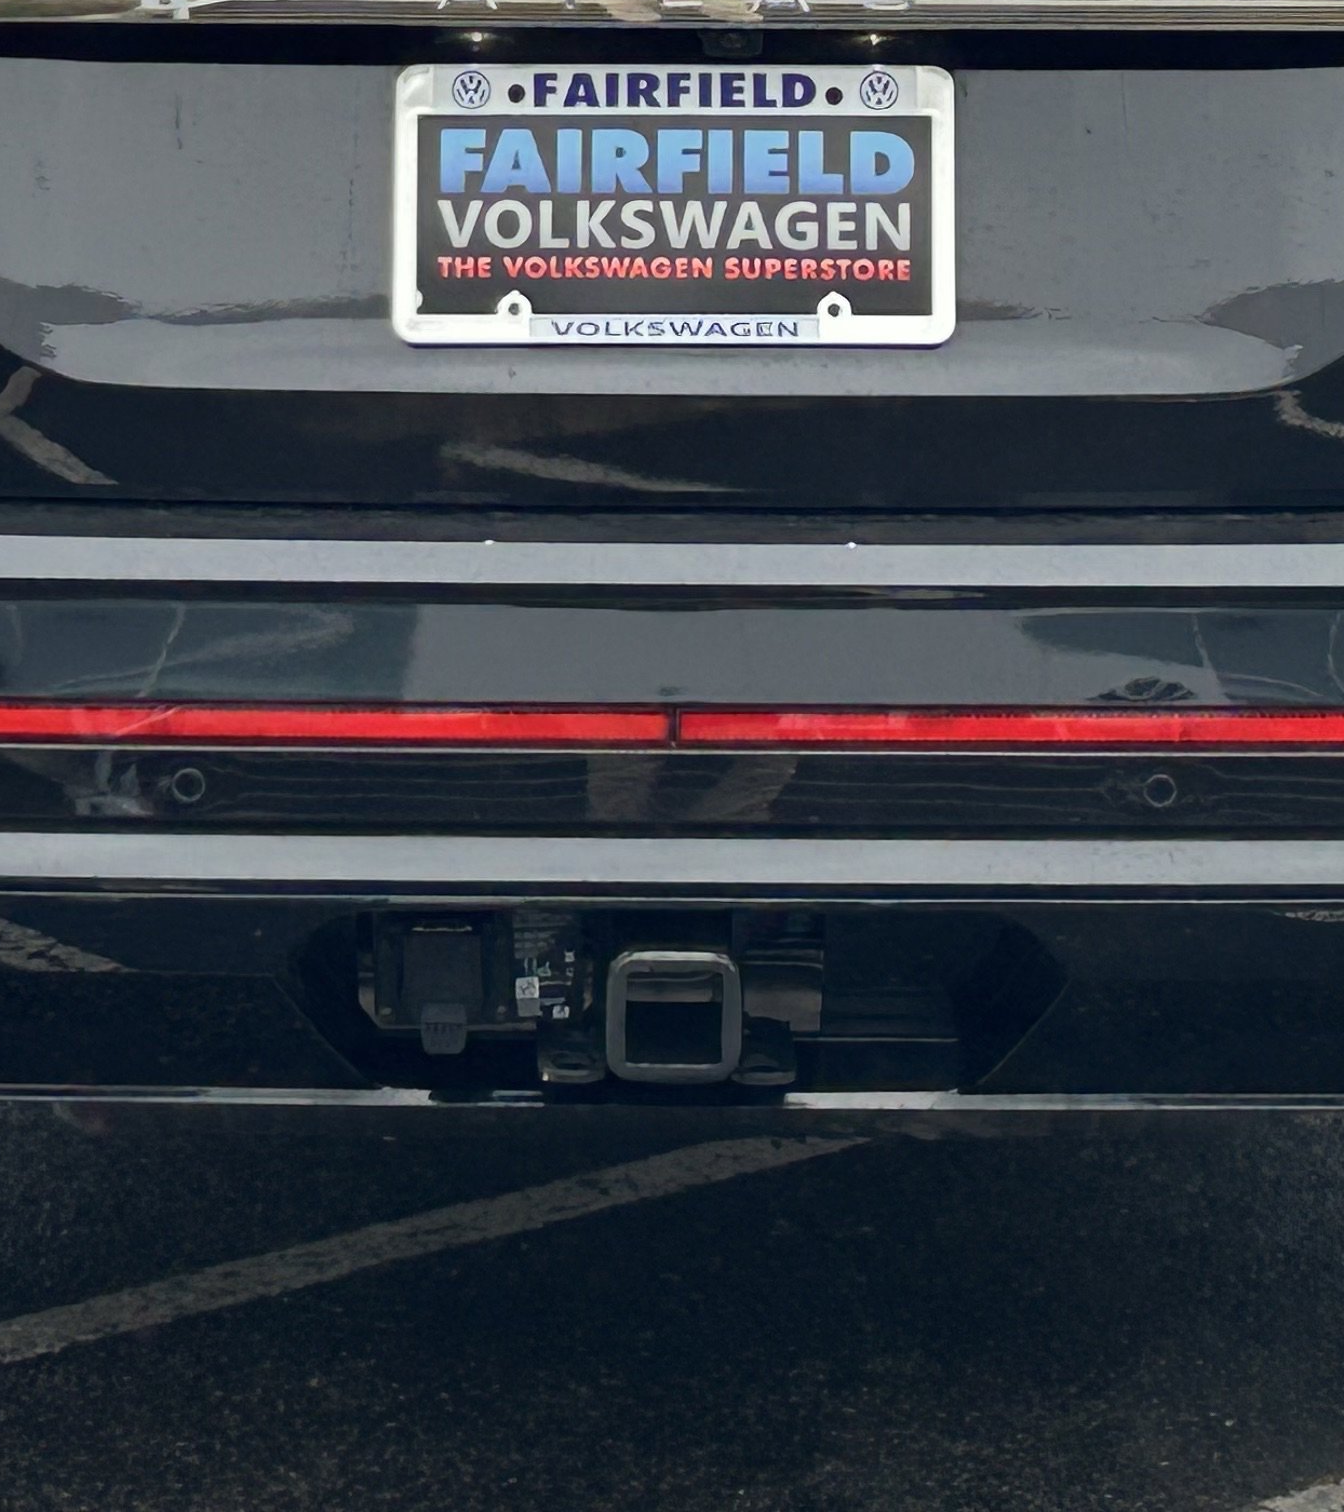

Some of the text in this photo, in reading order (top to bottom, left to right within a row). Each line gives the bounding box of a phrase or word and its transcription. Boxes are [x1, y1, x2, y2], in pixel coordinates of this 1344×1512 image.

[533, 73, 817, 109] FAIRFIELD
[436, 128, 916, 195] FAIRFIELD
[436, 199, 912, 251] VOLKSWAGEN
[437, 255, 911, 281] THE VOLKSWAGEN SUPERSTORE
[551, 320, 800, 339] VOLKSWAGEN
